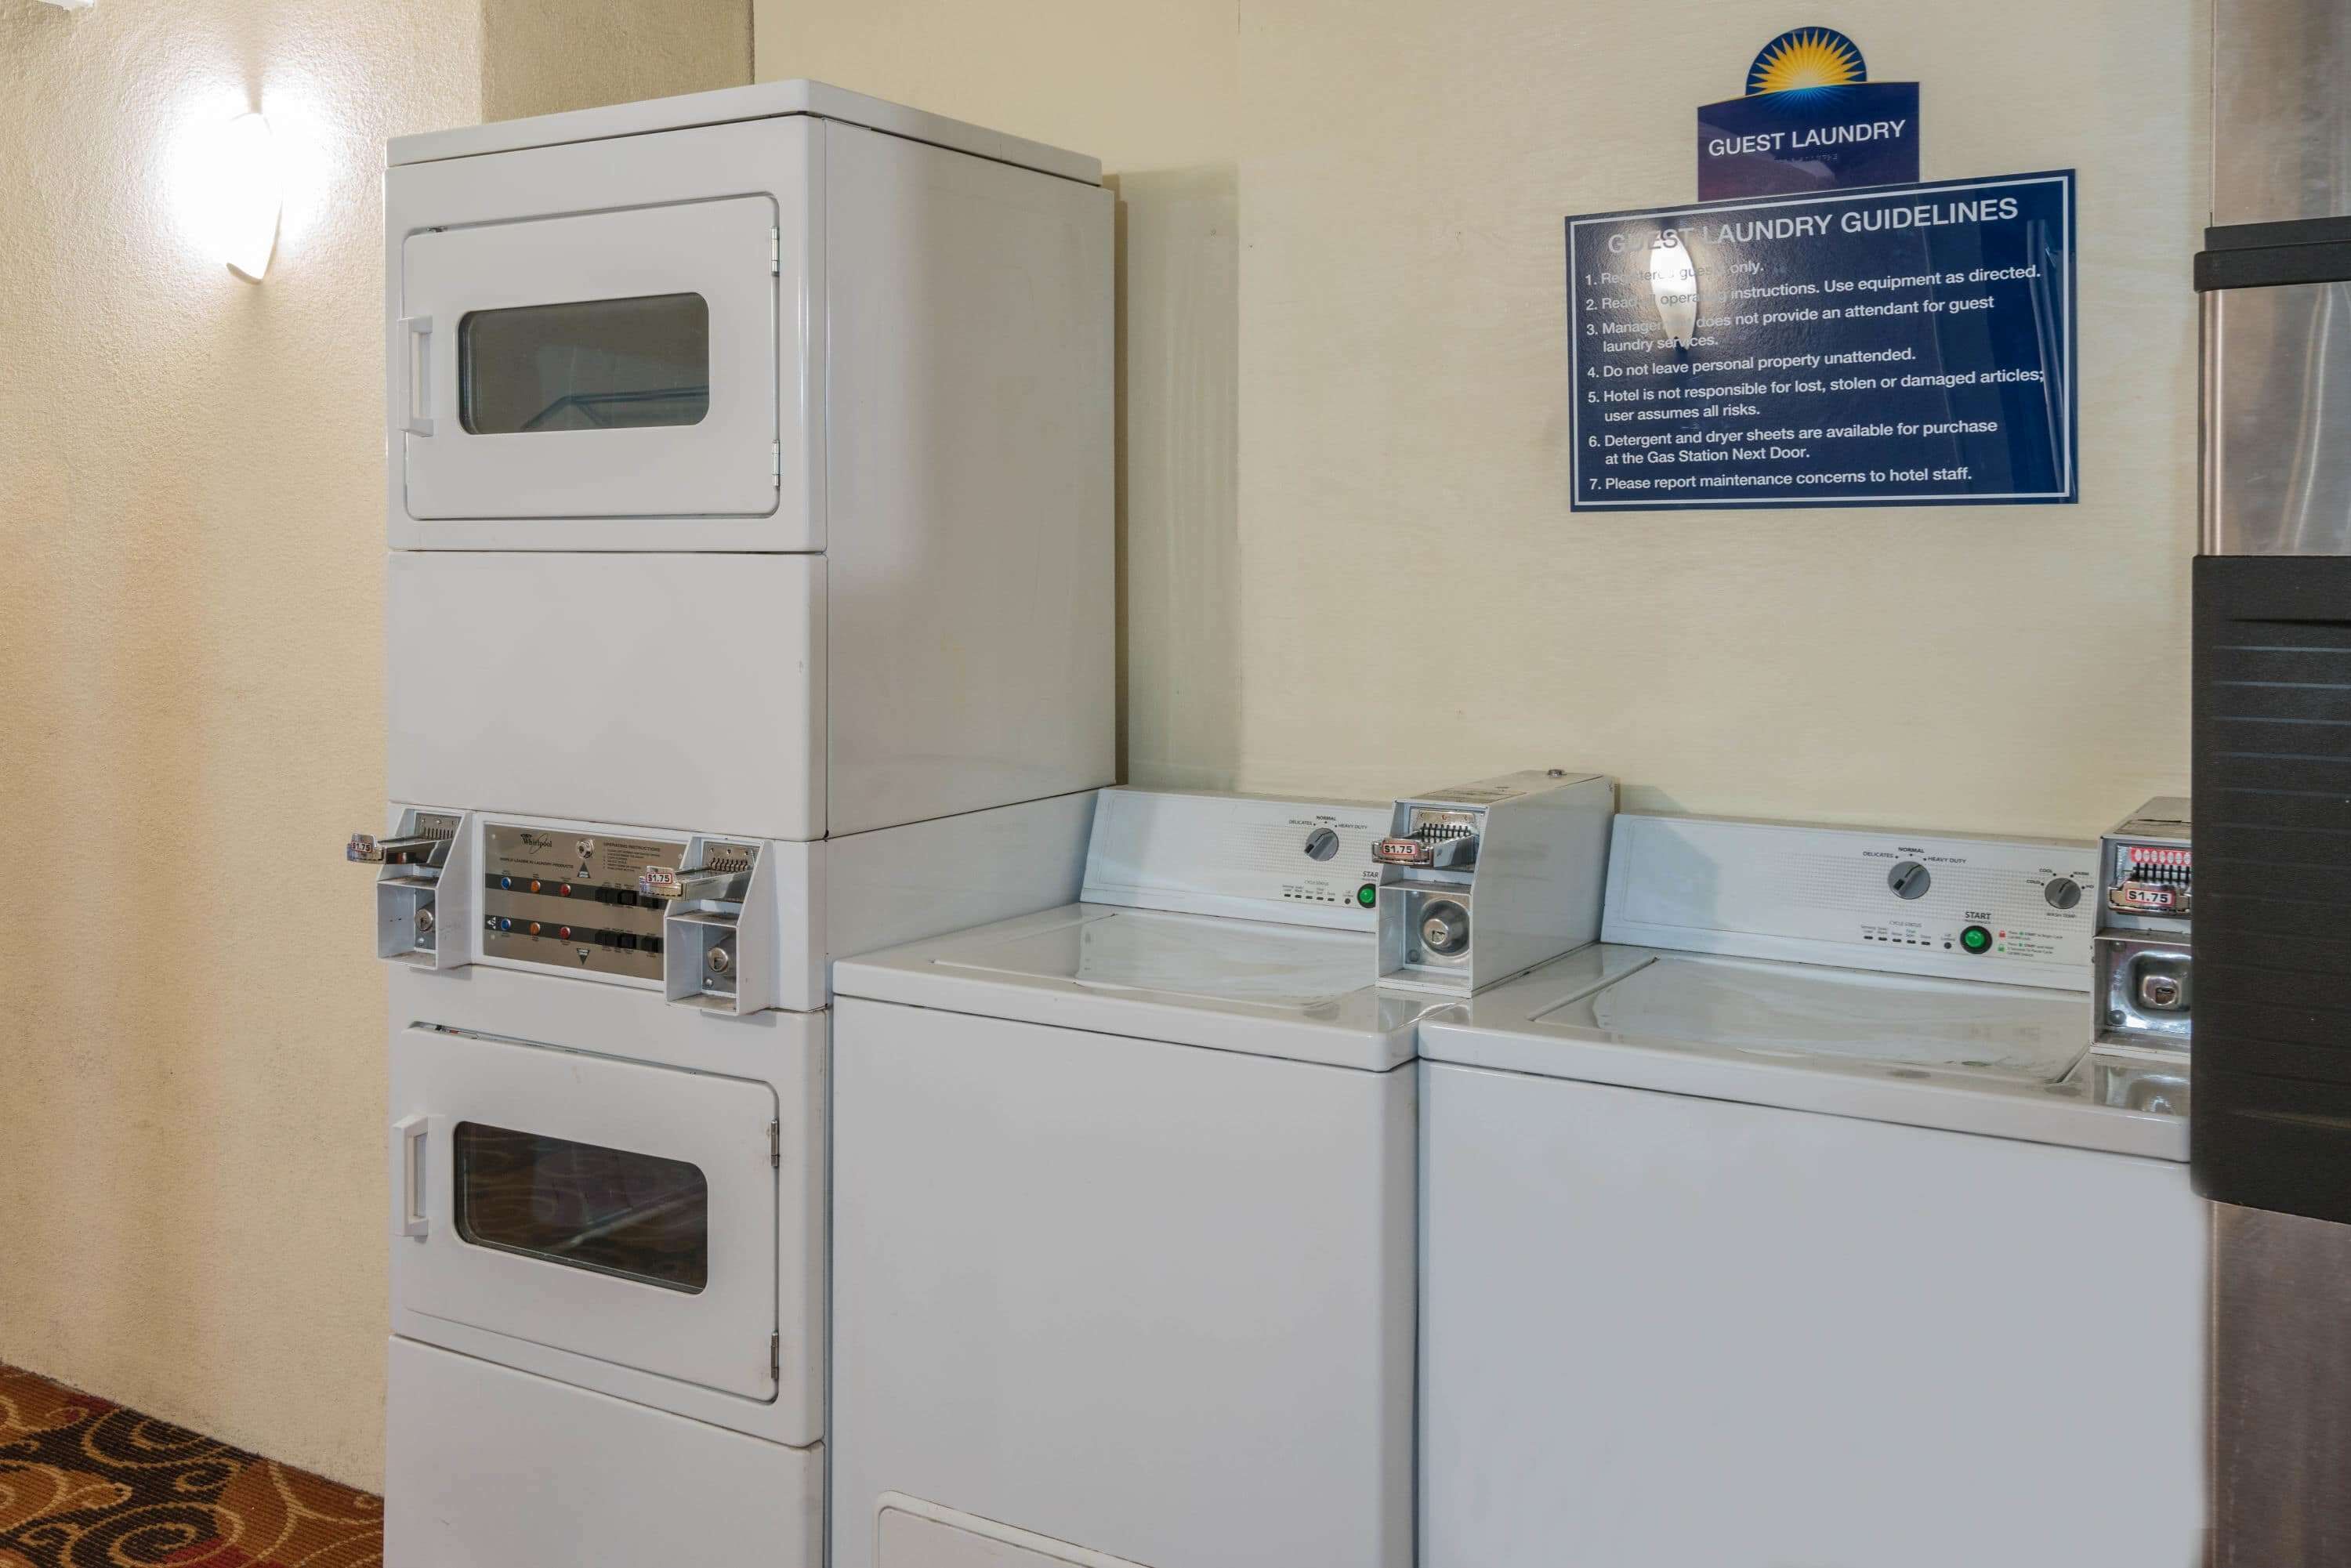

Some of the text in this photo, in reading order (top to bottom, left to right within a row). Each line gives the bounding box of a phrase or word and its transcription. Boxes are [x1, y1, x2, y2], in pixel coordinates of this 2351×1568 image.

[1708, 119, 1906, 156] GUEST LAUNDRY
[1608, 197, 2019, 253] GUEST LAUNDRY GUIDELINES
[1585, 274, 1597, 285] 1.
[1730, 261, 1764, 274] only.
[1585, 299, 1597, 311] 2.
[1602, 296, 1638, 310] Read
[1730, 283, 1820, 299] instructions.
[1824, 279, 1854, 293] Use
[1858, 273, 1942, 292] equipment
[1945, 272, 1965, 284] as
[1969, 265, 2041, 282] directed.
[1586, 324, 1599, 335] 3.
[1696, 314, 1731, 328] does
[1735, 312, 1759, 324] not
[1762, 306, 1818, 326] provide
[1822, 306, 1841, 319] an
[1845, 300, 1919, 318] attendant
[1923, 299, 1946, 312] for
[1949, 295, 1994, 313] guest
[1603, 338, 1653, 353] laundry
[1587, 347, 1916, 378] 4. Do not leave personal property unattended.
[1588, 368, 2045, 403] 5. Hotel is not responsible for lost, stolen or damaged articles;
[1605, 403, 1760, 422] user assumes all risks.
[1588, 420, 1998, 449] 6. Detergent and dryer sheets are available for purchase
[1605, 447, 1810, 465] at the Gas Station Next Door.
[1589, 466, 1972, 491] 7. Please report maintenance concerns to hotel staff.
[352, 842, 370, 852] $1.75
[523, 837, 552, 849] Whirlpool
[1384, 845, 1413, 854] $1.75
[647, 874, 670, 882] $1.75
[2128, 890, 2168, 904] $1.75
[1965, 911, 1992, 920] START
